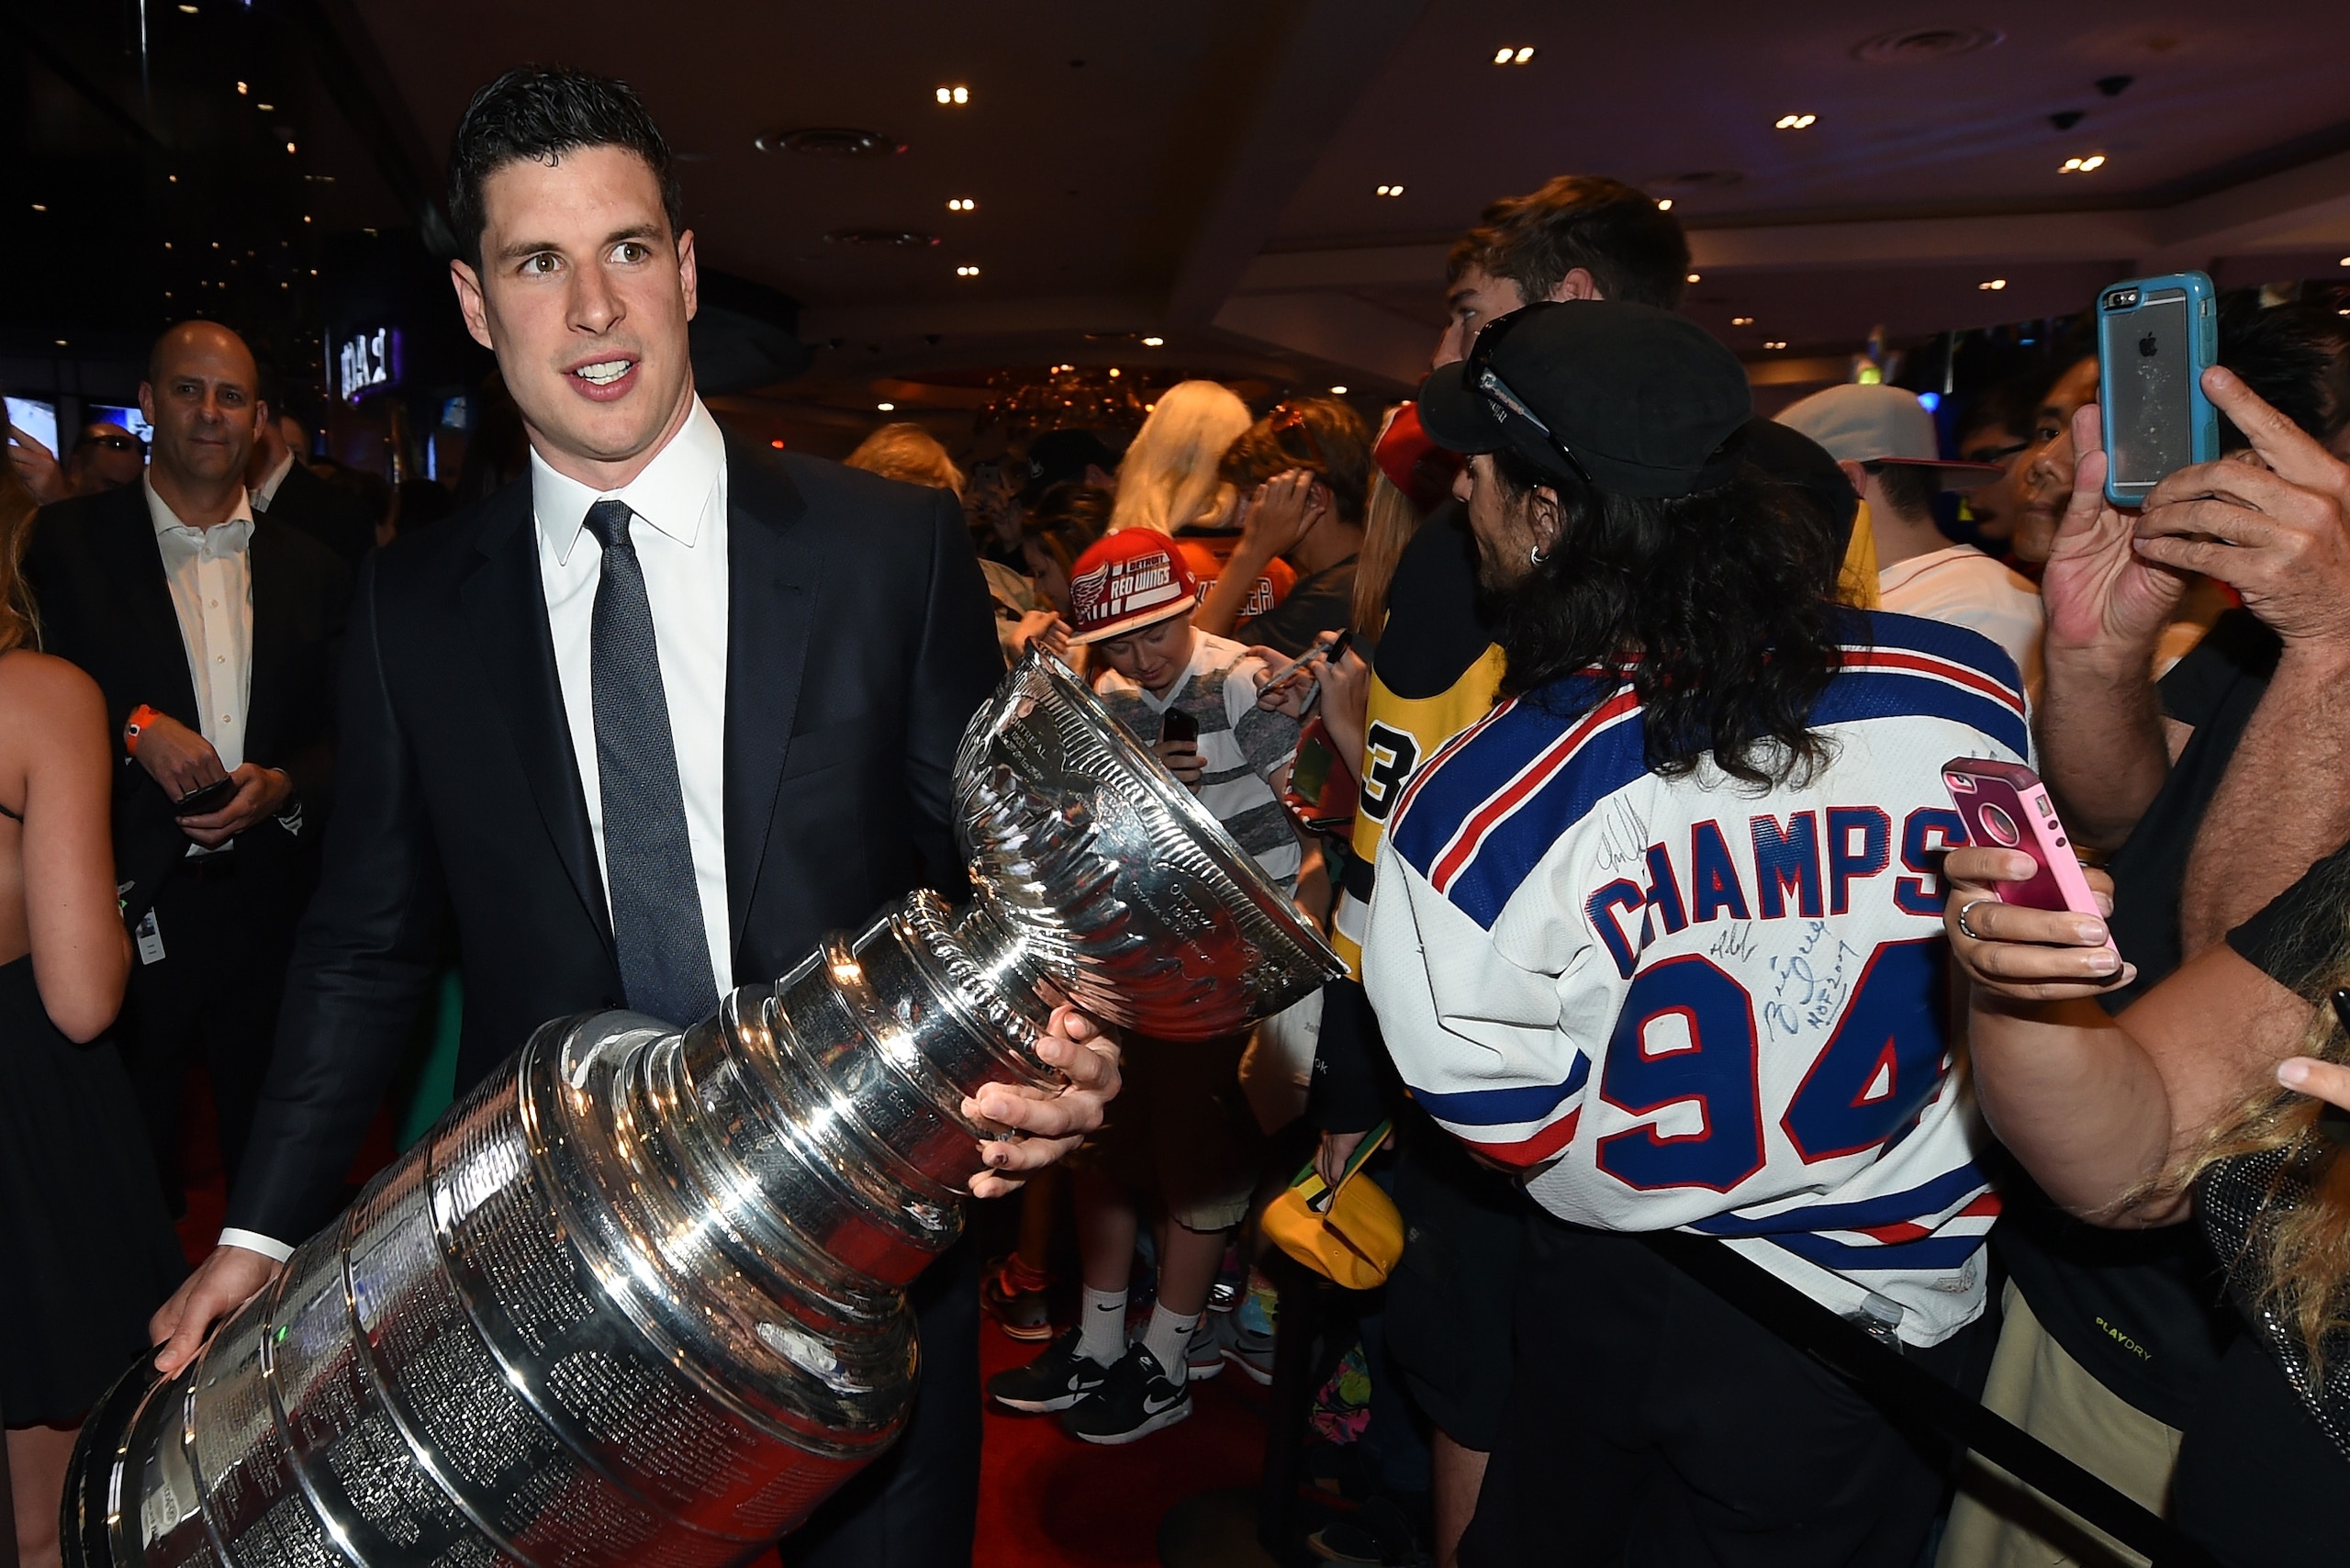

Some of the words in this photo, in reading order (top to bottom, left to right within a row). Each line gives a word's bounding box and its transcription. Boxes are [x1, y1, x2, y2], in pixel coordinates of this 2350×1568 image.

[1111, 577, 1134, 599] RED
[1135, 566, 1170, 591] WINGS
[1129, 554, 1165, 571] DETROIT
[1169, 883, 1218, 935] OTTAWA
[1584, 805, 1972, 980] CHAMPS
[1595, 935, 1953, 1195] 94
[2096, 1316, 2152, 1361] PLAYDRY
